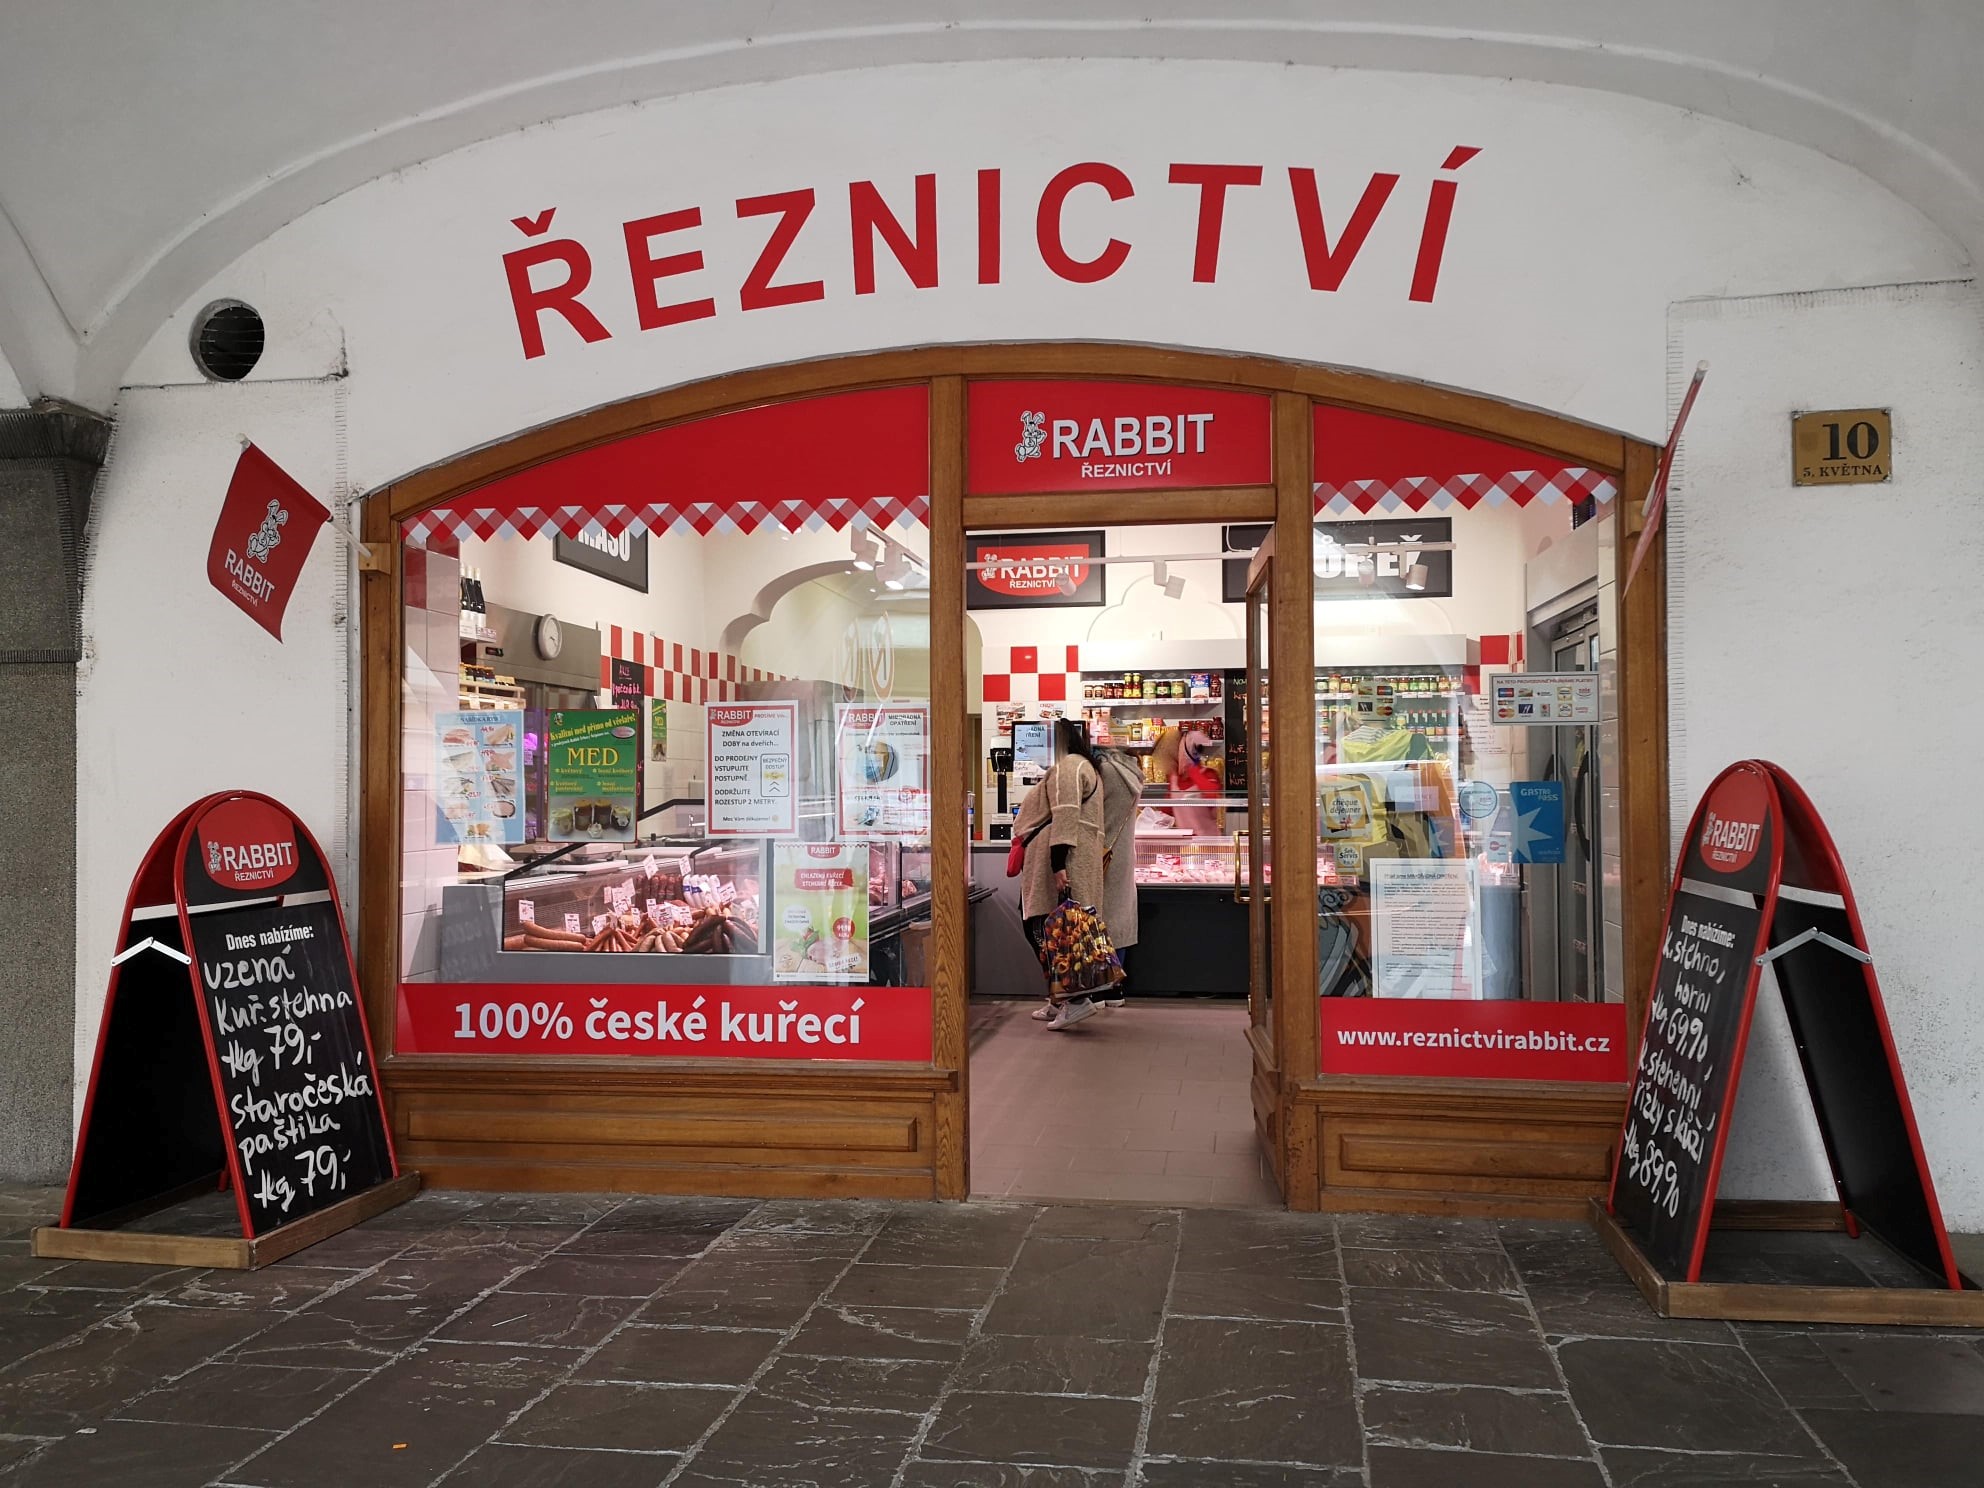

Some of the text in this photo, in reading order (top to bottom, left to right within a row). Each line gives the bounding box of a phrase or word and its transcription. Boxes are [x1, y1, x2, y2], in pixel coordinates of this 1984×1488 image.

[502, 146, 1483, 360] ŘEZNICTVÍ
[1053, 413, 1214, 459] RABBIT
[1822, 422, 1879, 460] 10
[1081, 459, 1172, 478] ŘEZNICTVÍ
[1803, 464, 1882, 478] 5. KVĚTNA
[225, 548, 275, 602] RABBIT
[1010, 577, 1056, 588] ŘEZNICTVÍ
[717, 710, 752, 720] RABBIT
[848, 713, 884, 722] RABBT
[746, 728, 780, 736] OTEVÍRACÍ
[568, 748, 620, 766] MED
[714, 787, 751, 795] DODRŽUJTE
[1520, 788, 1551, 796] GASTRO
[1710, 820, 1760, 852] RABBIT
[222, 842, 292, 870] RABBIT
[234, 868, 274, 882] ŘEZNICTVÍ
[226, 924, 314, 950] Dnes nabízíme:
[1680, 915, 1698, 936] Dnes
[453, 996, 865, 1044] 100% české kuřecí
[1337, 1027, 1610, 1052] www.reznictvirabbit.cz
[1666, 1008, 1708, 1062] 69,90
[238, 1110, 341, 1176] paštika
[1640, 1139, 1680, 1218] 89,90
